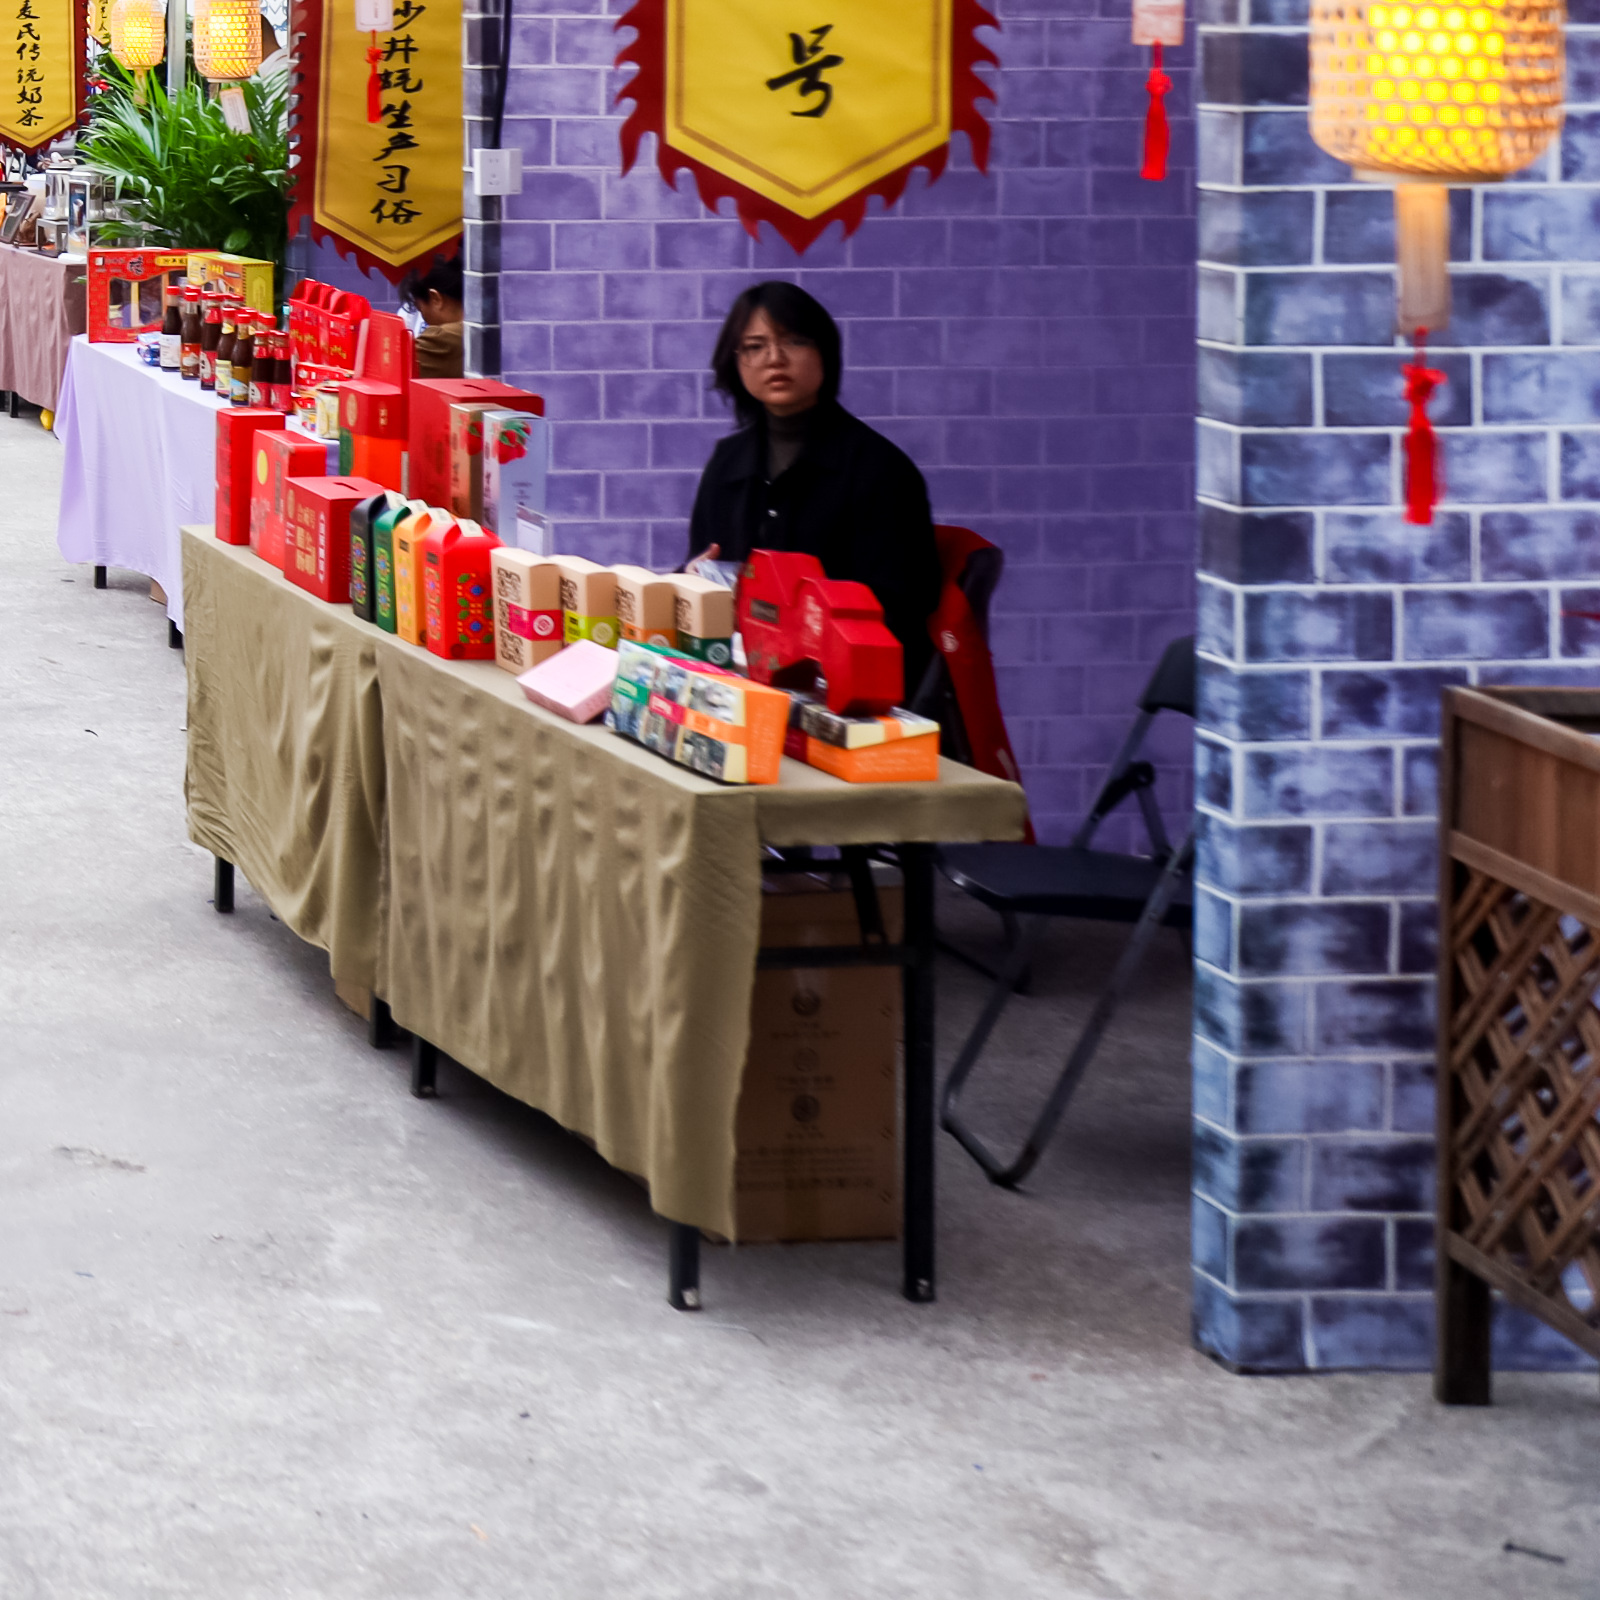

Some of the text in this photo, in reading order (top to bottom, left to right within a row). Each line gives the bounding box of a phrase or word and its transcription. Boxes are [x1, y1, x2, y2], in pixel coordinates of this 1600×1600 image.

[16, 0, 44, 126] 麦氏传统奶茶
